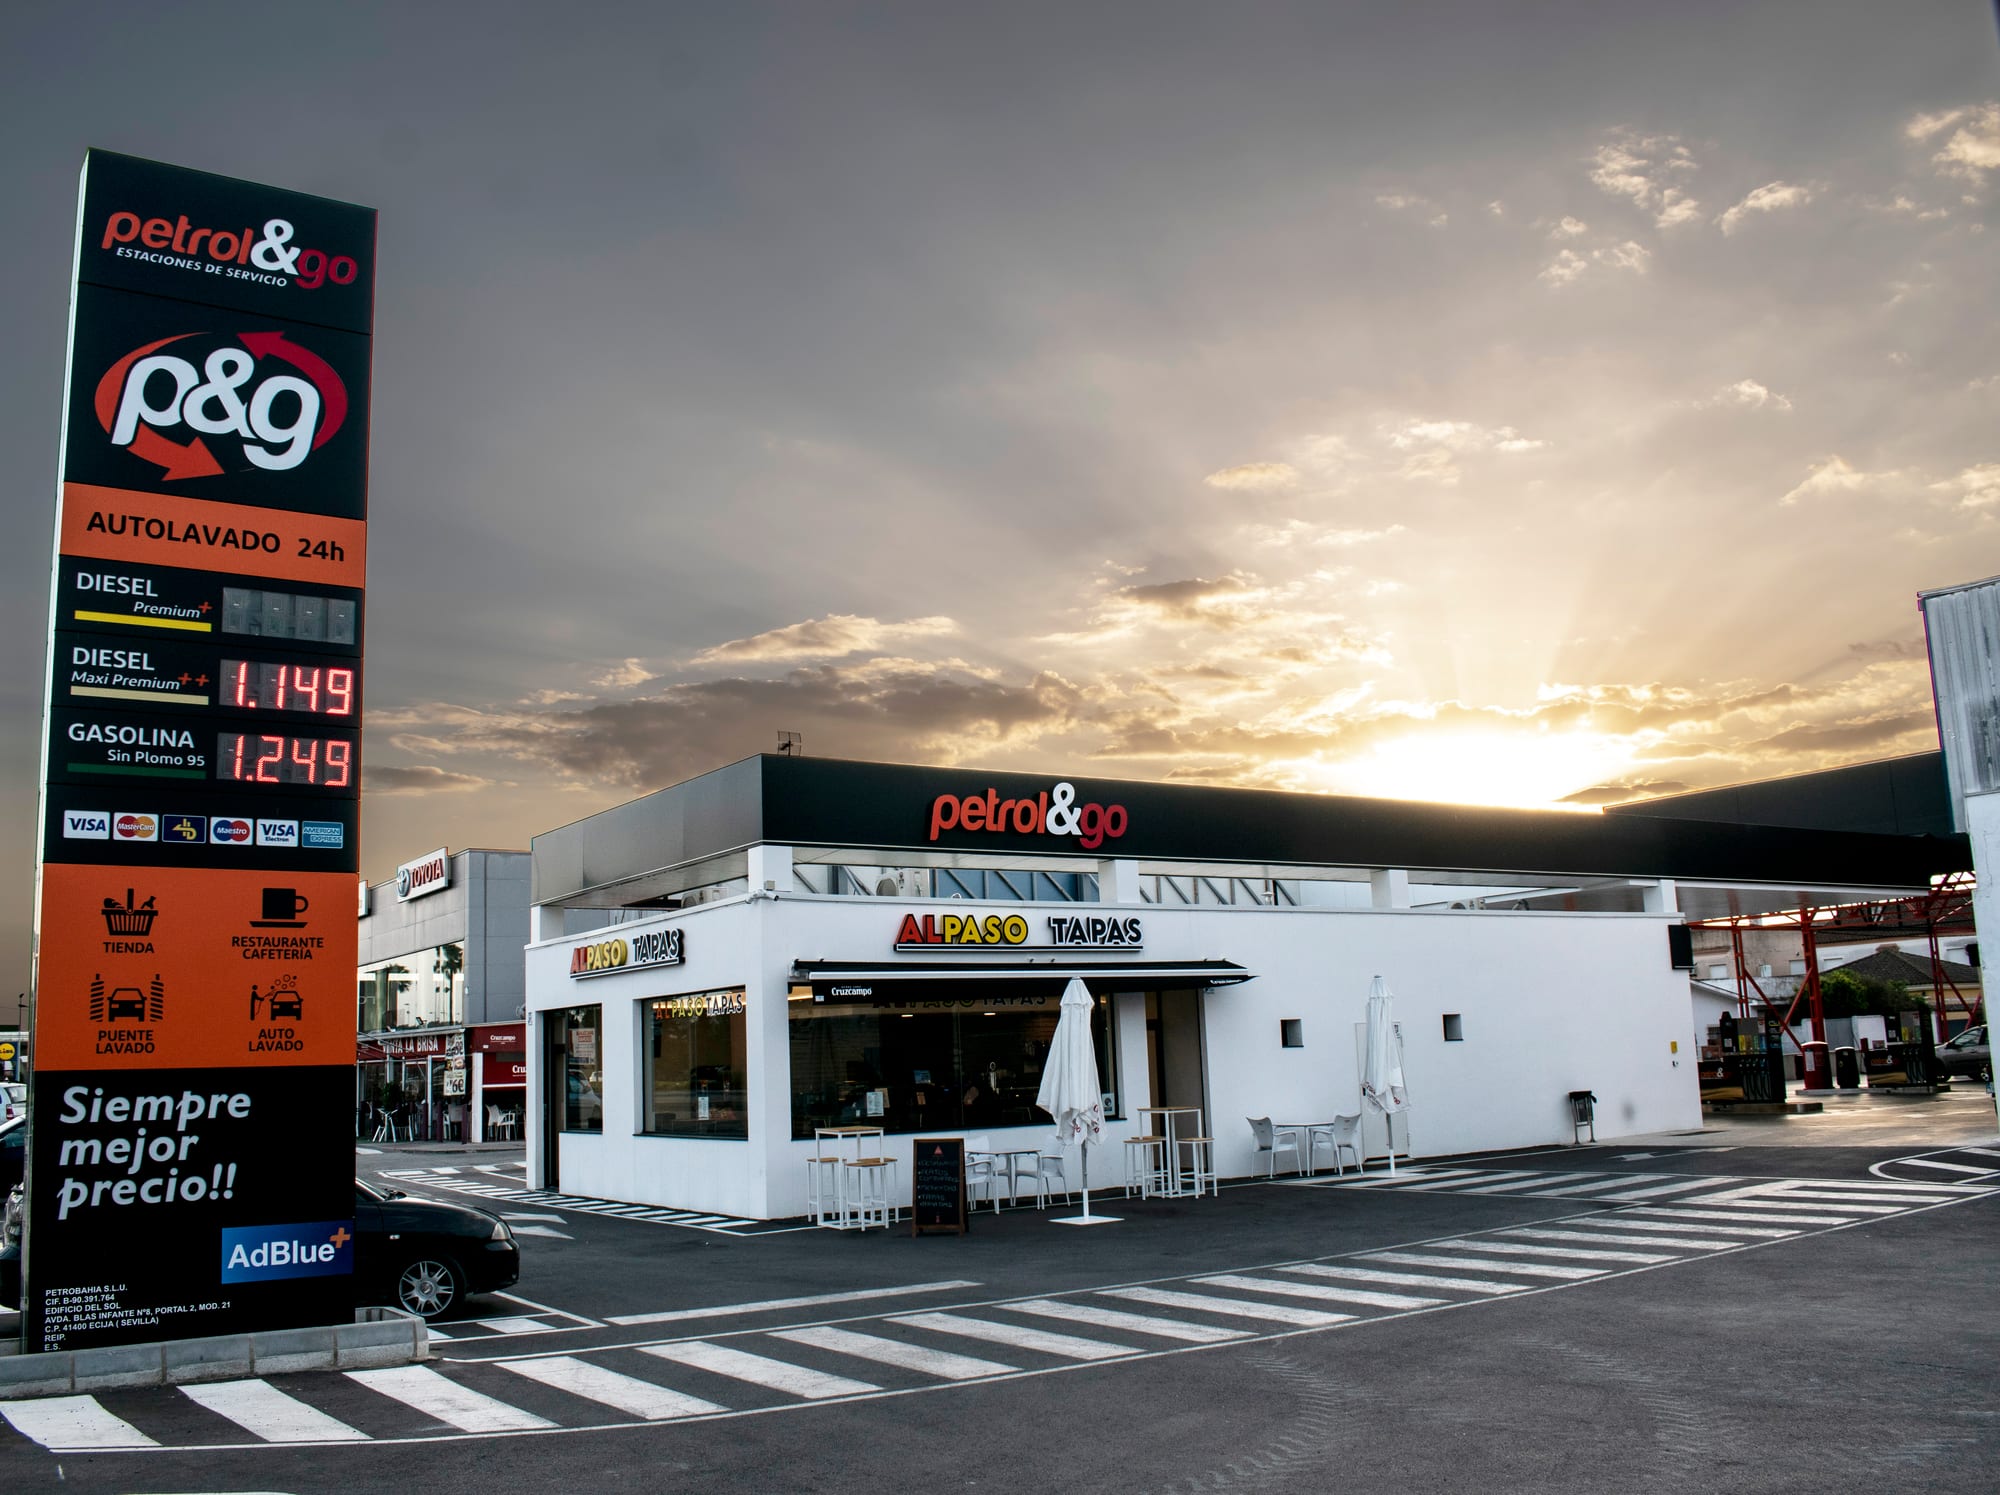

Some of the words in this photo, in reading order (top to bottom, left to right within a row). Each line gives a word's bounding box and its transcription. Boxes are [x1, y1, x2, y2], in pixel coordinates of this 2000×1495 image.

[101, 211, 358, 289] petrol&go
[116, 247, 201, 271] ESTACIONES
[205, 262, 222, 275] DE
[225, 267, 288, 287] SERVICIO
[111, 347, 321, 471] p&g
[86, 511, 281, 553] AUTOLAVADO
[297, 538, 345, 562] 24h
[76, 572, 158, 597] DIESEL
[72, 647, 155, 671] DIESEL
[71, 672, 108, 685] Maxi
[236, 661, 353, 715] 1.149
[67, 722, 195, 748] GASOLINA
[107, 749, 130, 762] Sin
[135, 752, 183, 765] Plomo
[187, 755, 205, 767] 95
[233, 735, 351, 787] 1.249
[929, 782, 1128, 849] petrol&go
[68, 817, 107, 832] VISA
[117, 823, 155, 831] MasterCard
[217, 827, 248, 835] Maestro
[261, 823, 295, 837] VISA
[303, 827, 340, 835] AMERICAN
[310, 835, 343, 843] EXPRESS
[411, 858, 444, 888] TOYOTA
[1047, 916, 1142, 946] TAPAS
[103, 942, 155, 954] TIENDA
[231, 936, 324, 948] RESTAURANTE
[632, 928, 684, 964] TAPAS
[831, 986, 873, 997] Cruzcampo
[705, 993, 744, 1017] TAPAS
[97, 1030, 154, 1042] PUENTE
[258, 1028, 295, 1040] AUTO
[96, 1042, 155, 1055] LAVADO
[248, 1039, 304, 1052] LAVADO
[417, 1035, 438, 1052] BRISA
[59, 1086, 251, 1131] Siempre
[58, 1128, 199, 1174] mejor
[56, 1163, 237, 1220] precio!!
[45, 1285, 102, 1297] PETROBAHIA
[103, 1284, 128, 1292] S.L.U.
[45, 1298, 61, 1306] CIF.
[63, 1293, 115, 1305] B-90.391.764
[45, 1305, 83, 1315] EDIFICIO
[84, 1303, 102, 1312] DEL
[103, 1302, 121, 1310] SOL
[45, 1315, 72, 1324] AVDA.
[73, 1313, 97, 1322] BLAS
[98, 1310, 135, 1320] INFANTE
[155, 1305, 188, 1315] PORTAL
[189, 1304, 197, 1312] 2,
[198, 1302, 220, 1311] MOD.
[221, 1301, 231, 1309] 21
[45, 1325, 61, 1333] C.P.
[62, 1322, 87, 1332] 41400
[88, 1320, 115, 1330] ECIJA
[44, 1333, 67, 1342] REIP.
[44, 1343, 62, 1351] E.S.
